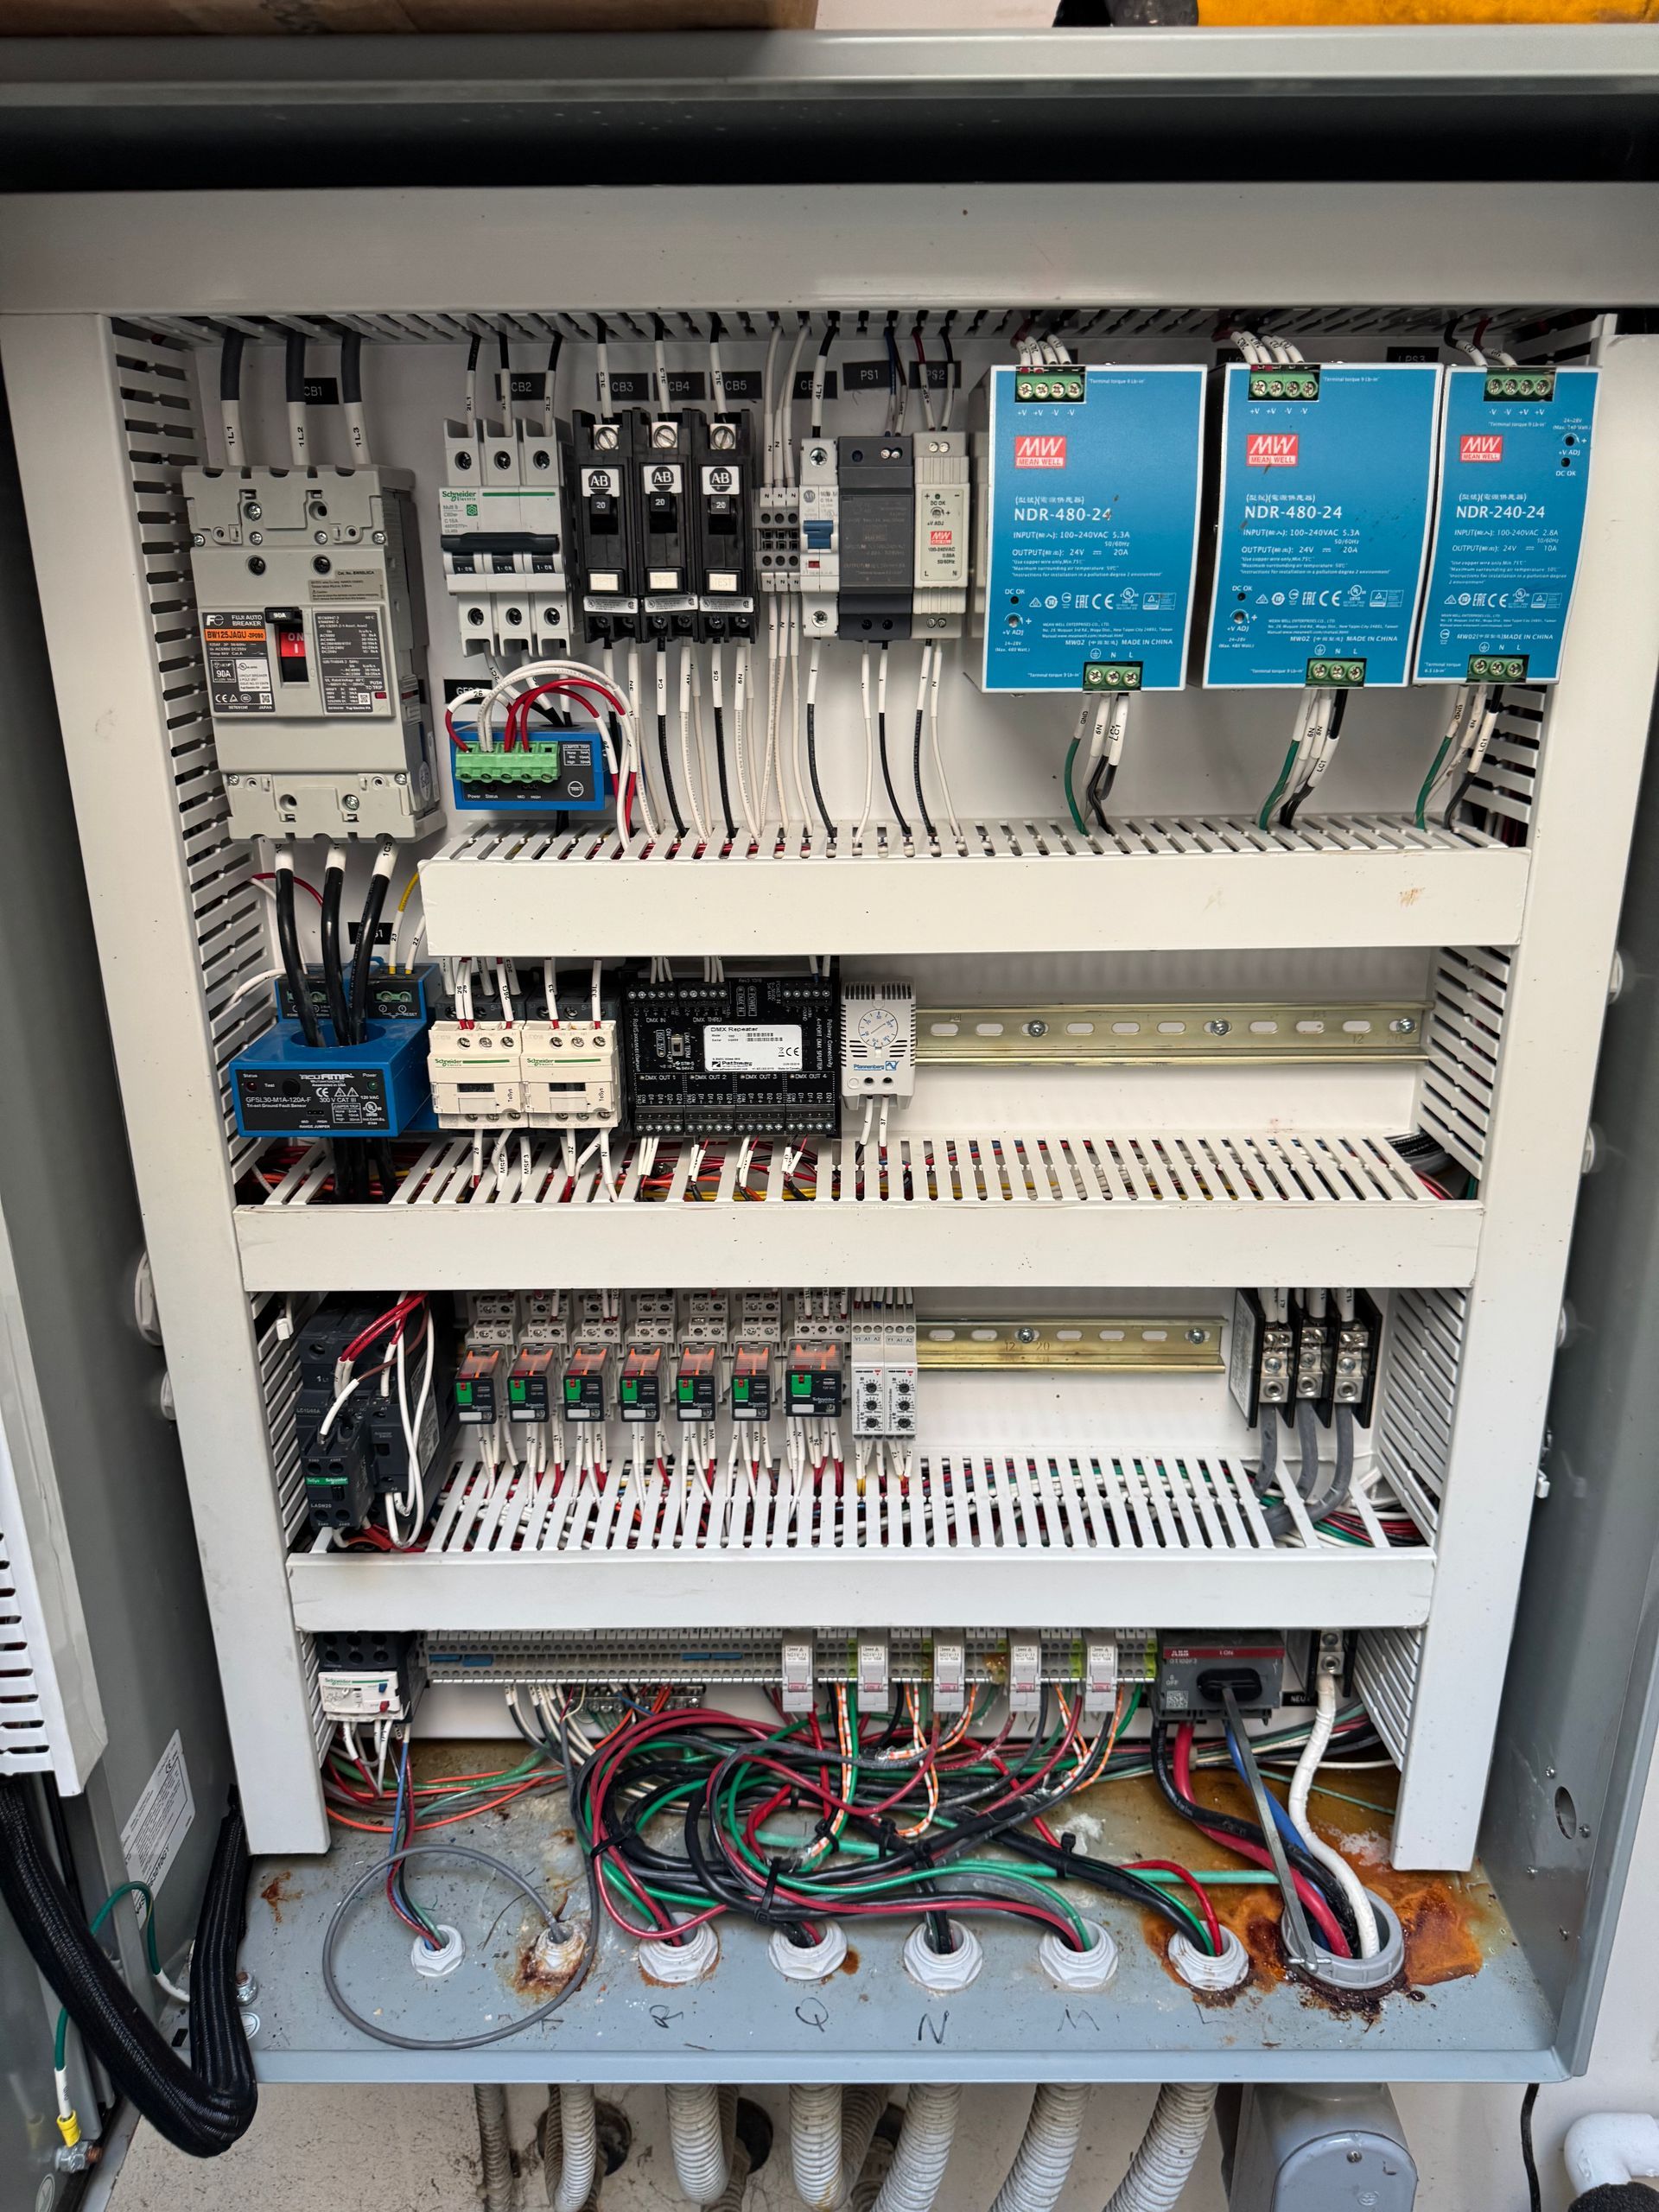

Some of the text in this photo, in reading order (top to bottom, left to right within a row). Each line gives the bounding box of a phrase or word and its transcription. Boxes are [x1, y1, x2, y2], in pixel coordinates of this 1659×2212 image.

[861, 370, 879, 380] PS1
[926, 370, 945, 380] PS2
[512, 382, 533, 393] CB2
[612, 382, 634, 393] CB3
[667, 380, 691, 392] CB4
[726, 380, 747, 391] CB5
[1051, 408, 1060, 416] -V
[1066, 408, 1076, 416] -V
[353, 426, 362, 448] 1L3
[1018, 437, 1065, 457] MW
[1249, 435, 1296, 454] MW
[1462, 437, 1500, 453] MW
[1018, 458, 1062, 467] MEAN WELL
[589, 475, 609, 488] AB
[653, 471, 671, 484] AB
[711, 472, 730, 486] AB
[655, 498, 666, 506] 20
[1014, 508, 1112, 522] NDR-480-24
[1244, 506, 1343, 519] NDR-480-24
[1456, 505, 1545, 518] NDR-240-24
[1113, 531, 1131, 539] 5.3A
[1092, 593, 1116, 610] CE
[1319, 589, 1343, 607] CE
[1488, 593, 1510, 608] CE
[287, 632, 305, 642] ON
[216, 670, 232, 678] 90A
[658, 678, 664, 690] C4
[1080, 710, 1089, 725] GND
[1113, 724, 1122, 741] LC1
[1478, 738, 1488, 753] LC1
[1317, 760, 1327, 772] LC1
[383, 842, 393, 856] 1C3
[412, 937, 420, 946] 22
[786, 1047, 800, 1057] CE
[918, 2010, 950, 2044] N
